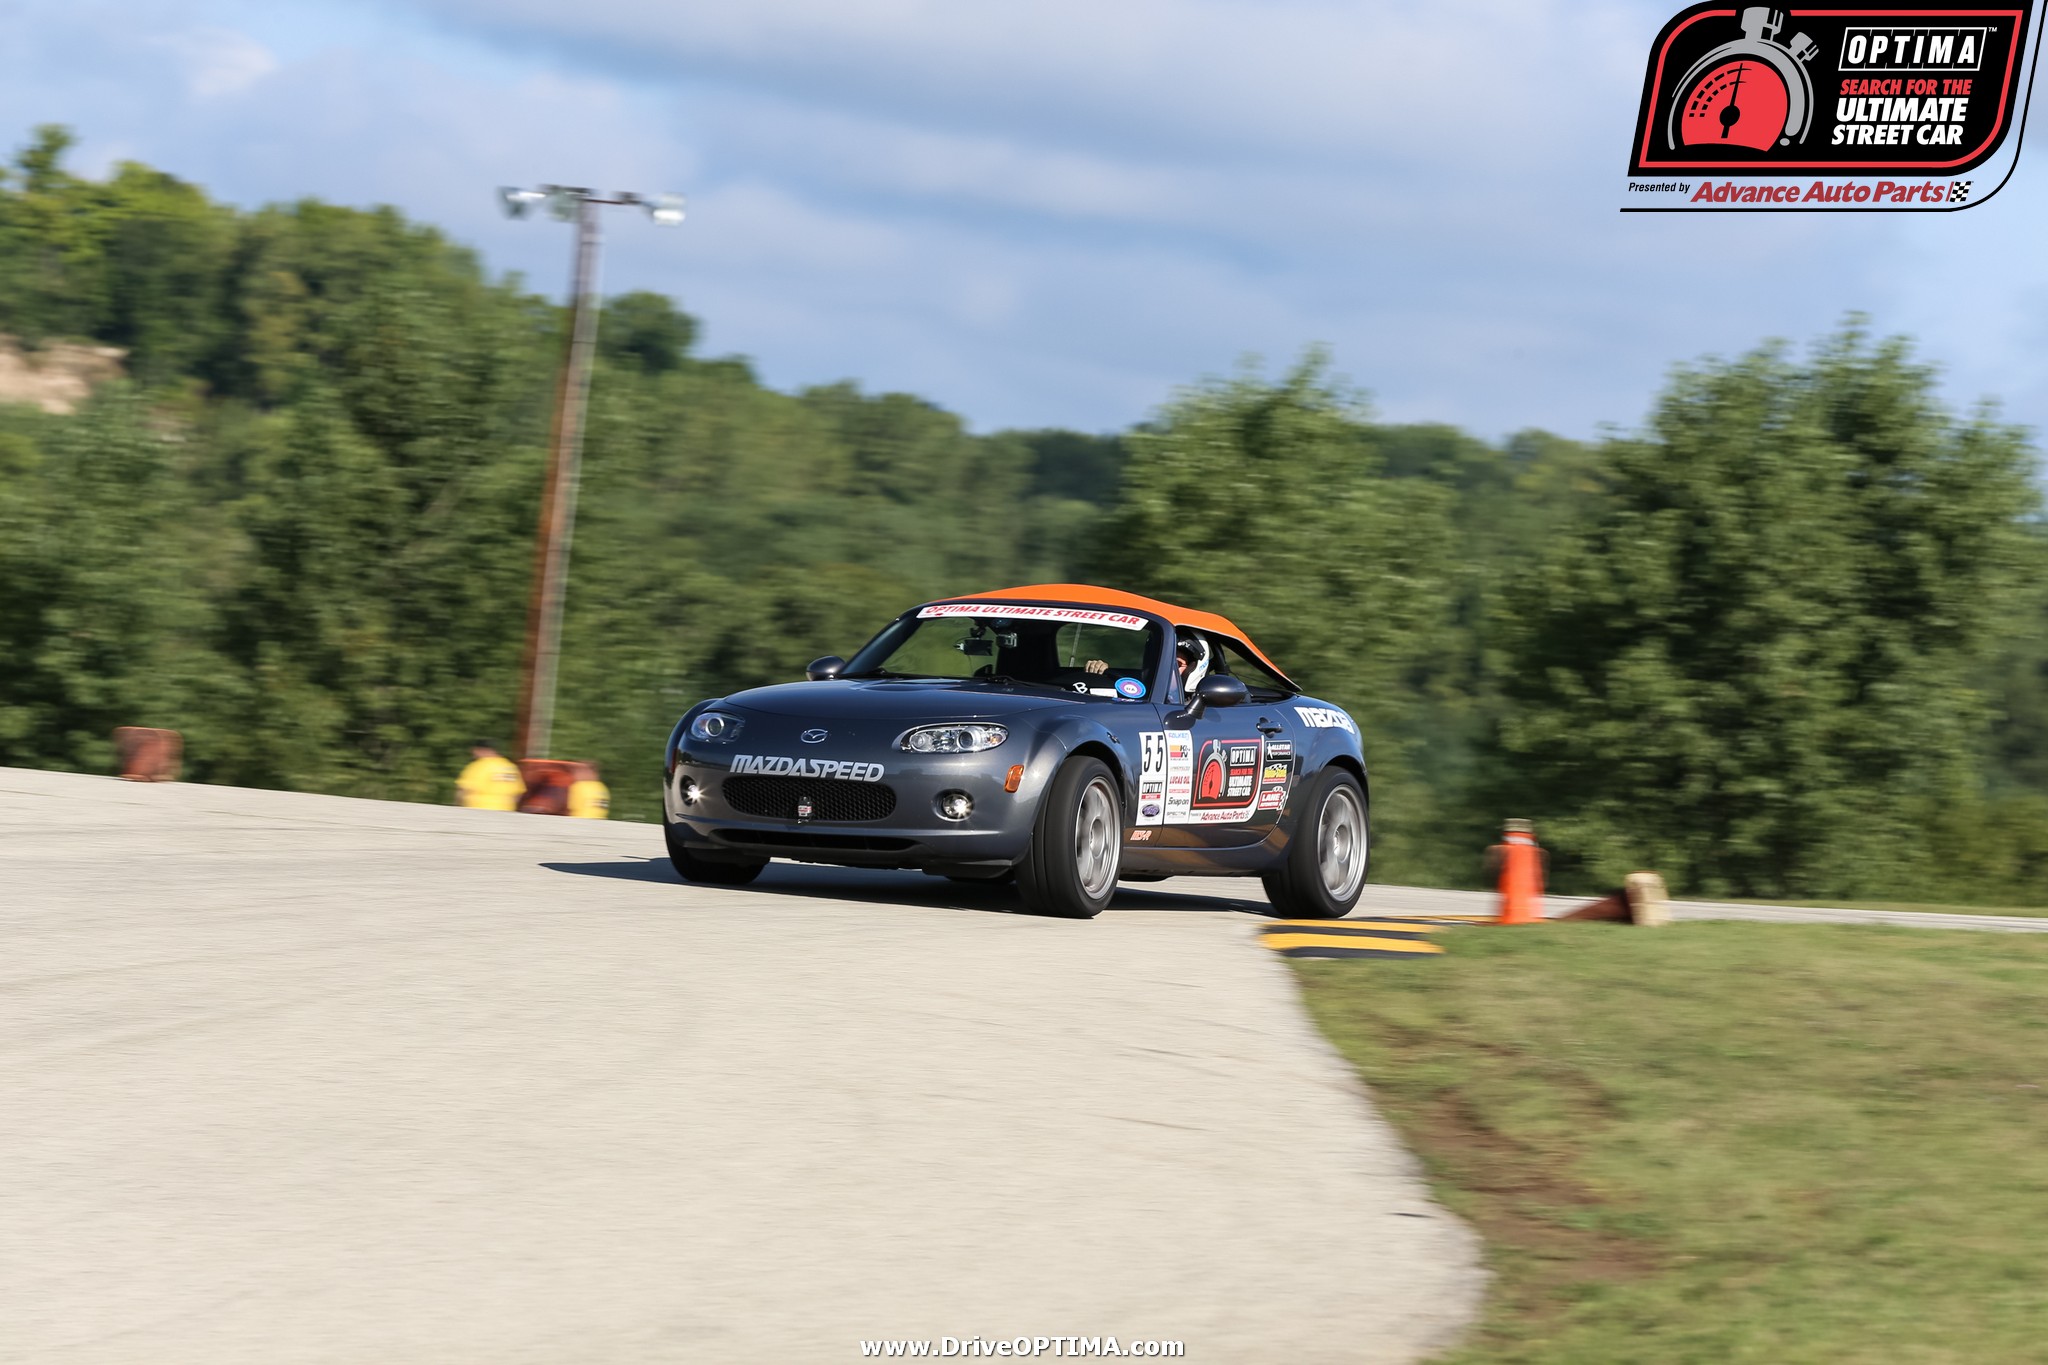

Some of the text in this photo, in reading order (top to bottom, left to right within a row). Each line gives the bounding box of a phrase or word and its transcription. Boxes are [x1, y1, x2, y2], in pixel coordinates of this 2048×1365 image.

[926, 605, 1140, 625] OPTIMA ULTIMATE STREET CAR
[1230, 749, 1254, 764] OPTIMA
[729, 754, 885, 782] MAZDASPEED
